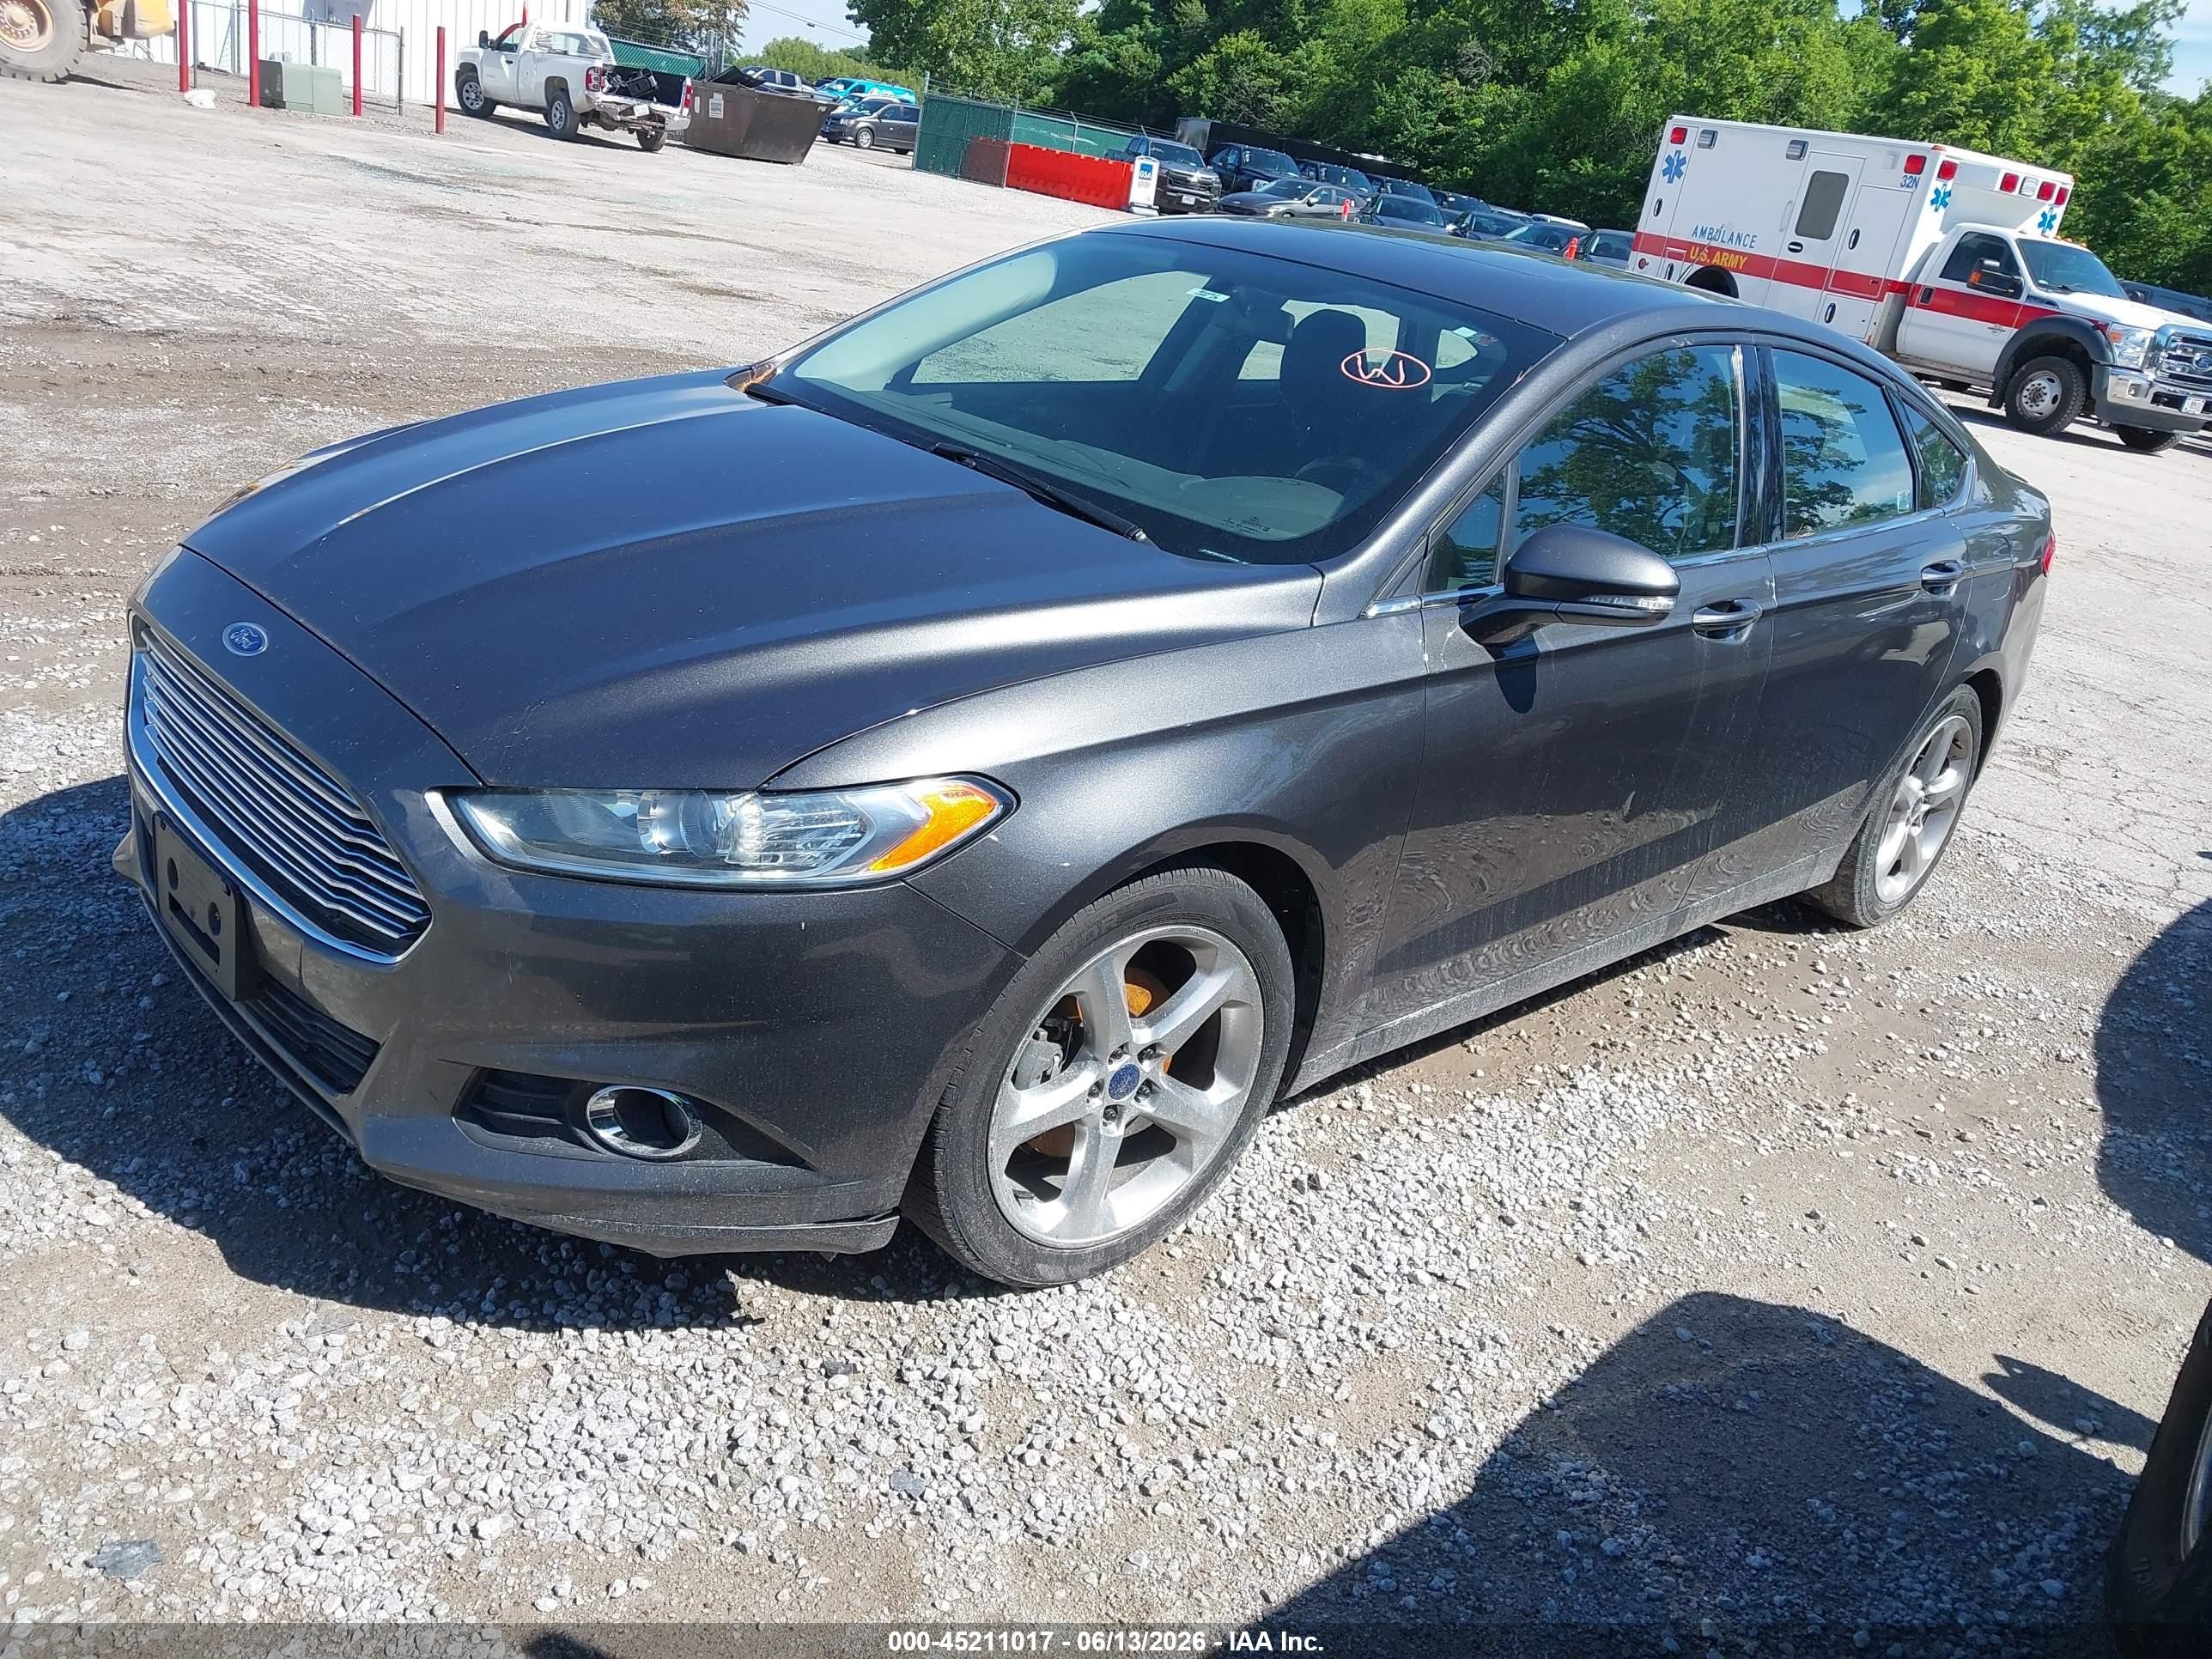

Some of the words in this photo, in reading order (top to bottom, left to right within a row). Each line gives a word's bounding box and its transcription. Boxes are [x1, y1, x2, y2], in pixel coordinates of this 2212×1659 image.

[1139, 170, 1152, 179] GSA
[1900, 174, 1921, 189] 32N
[1691, 224, 1758, 248] AMBULANCE
[1689, 246, 1711, 263] U.S.
[1711, 251, 1747, 270] ARMY
